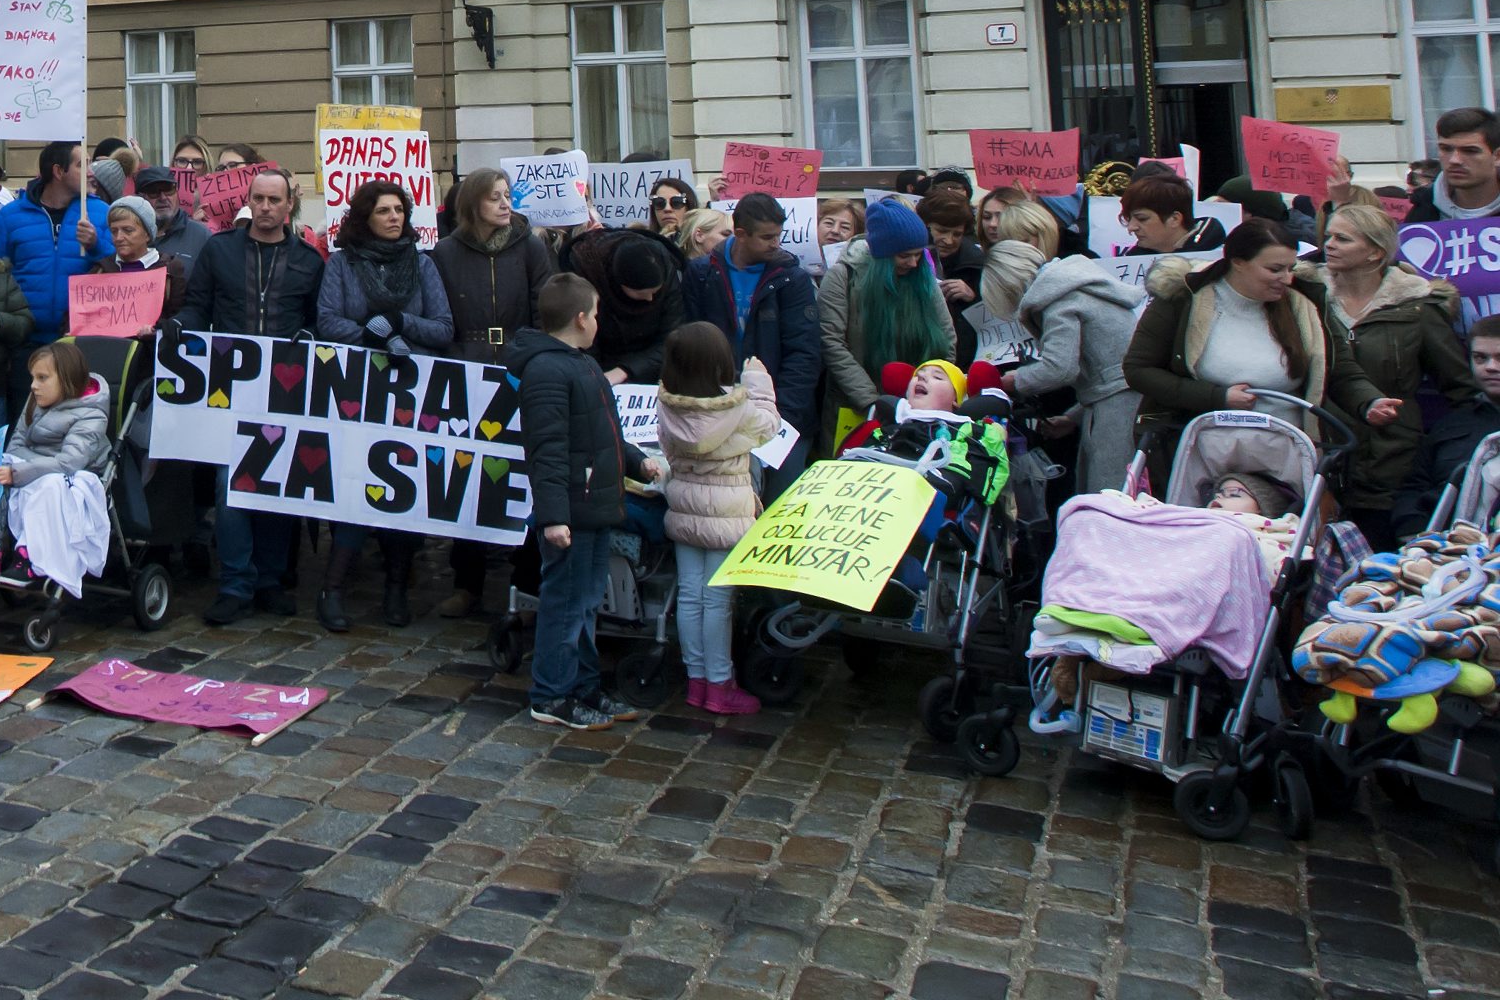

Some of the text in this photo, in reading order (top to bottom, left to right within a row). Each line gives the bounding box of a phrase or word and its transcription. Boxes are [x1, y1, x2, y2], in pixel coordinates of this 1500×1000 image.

[9, 1, 42, 13] STAV
[4, 29, 57, 45] DIAGNOZA
[998, 26, 1006, 38] 7
[4, 111, 22, 123] SVE
[325, 134, 428, 168] DANAS MI
[987, 137, 1054, 158] #SMA
[777, 151, 804, 163] STE
[516, 160, 580, 183] ZAKAZALI
[408, 170, 431, 207] VI
[535, 182, 567, 199] STE
[627, 395, 644, 409] DA
[632, 415, 647, 426] OD
[229, 420, 528, 533] ZA SVE
[799, 465, 896, 484] BITI ILI
[787, 481, 829, 497] NE
[770, 503, 894, 530] ZA MENE
[761, 523, 880, 551] ODLUČUJE
